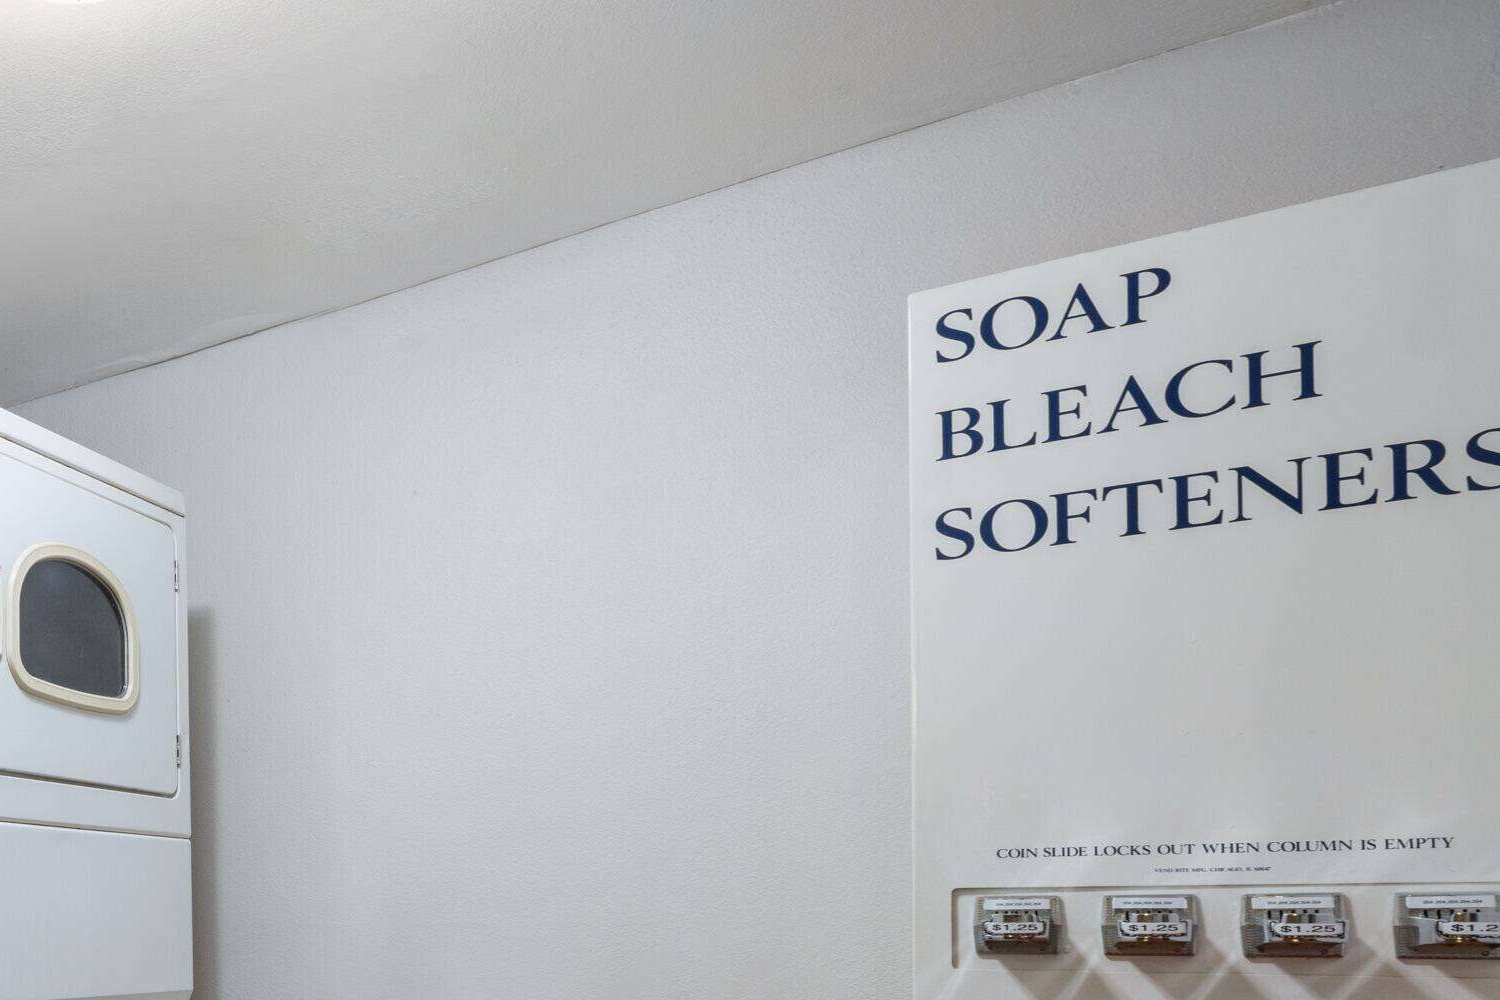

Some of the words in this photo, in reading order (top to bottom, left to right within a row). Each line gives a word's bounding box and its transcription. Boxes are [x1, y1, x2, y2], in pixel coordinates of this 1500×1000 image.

[936, 268, 1171, 362] SOAP
[936, 341, 1322, 461] BLEACH
[936, 428, 1500, 560] SOFTENERS
[996, 847, 1038, 859] COIN
[1043, 846, 1088, 858] SLIDE
[1093, 845, 1152, 857] LOCKS
[1157, 843, 1199, 856] OUT
[1200, 842, 1261, 855] WHEN
[1266, 839, 1354, 854] COLUMN
[1361, 838, 1377, 851] IS
[1384, 836, 1456, 850] EMPTY
[993, 924, 1038, 932] $1.25
[1128, 924, 1179, 932] $1.25
[1280, 924, 1336, 933] $1.25
